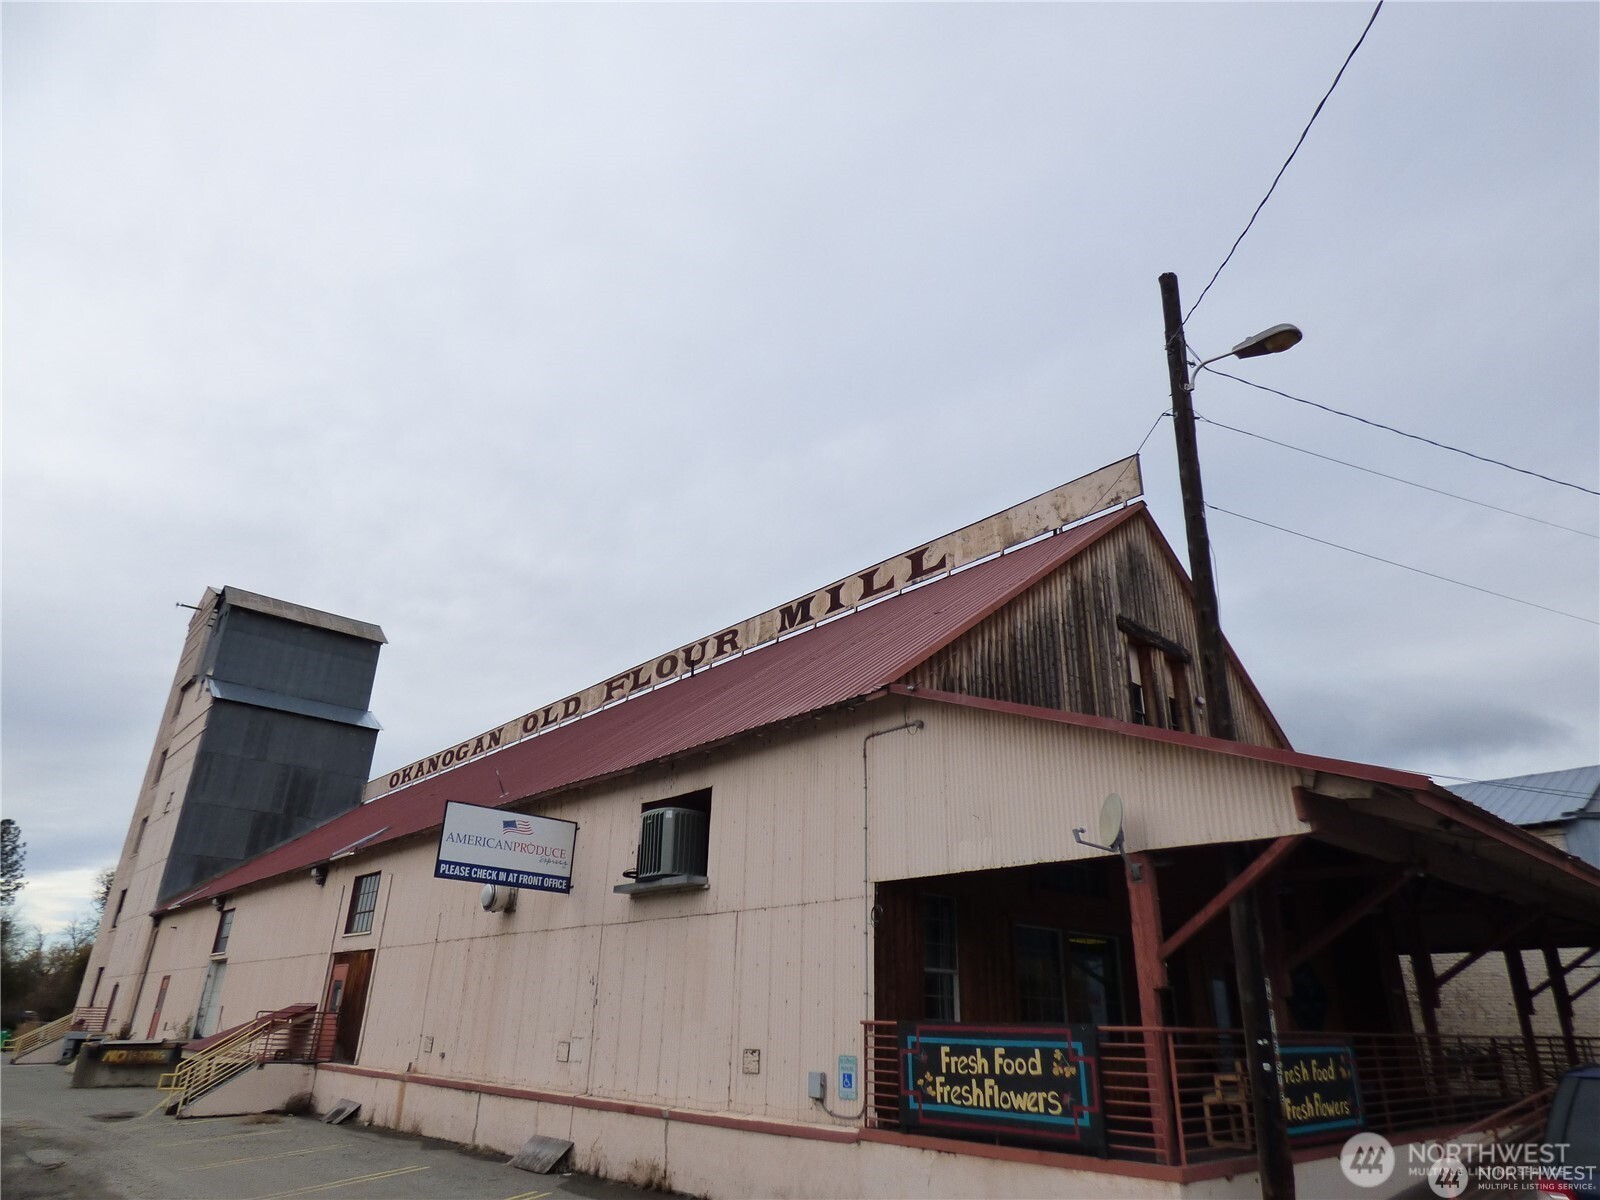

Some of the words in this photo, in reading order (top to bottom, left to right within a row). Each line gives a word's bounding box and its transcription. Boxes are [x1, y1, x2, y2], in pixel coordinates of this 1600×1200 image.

[389, 727, 504, 788] OKANOGAN
[522, 696, 581, 734] OLD
[602, 629, 740, 702] FLOUR
[778, 547, 947, 633] MILL
[440, 863, 470, 877] PLEASE
[471, 867, 497, 881] CHECK
[498, 871, 507, 881] IN
[508, 873, 518, 883] AT
[519, 874, 542, 887] FRONT
[543, 877, 567, 890] OFFICE
[940, 1046, 989, 1075] Fresh
[994, 1047, 1043, 1076] Food
[1283, 1060, 1309, 1084] resh
[1311, 1057, 1336, 1081] Food
